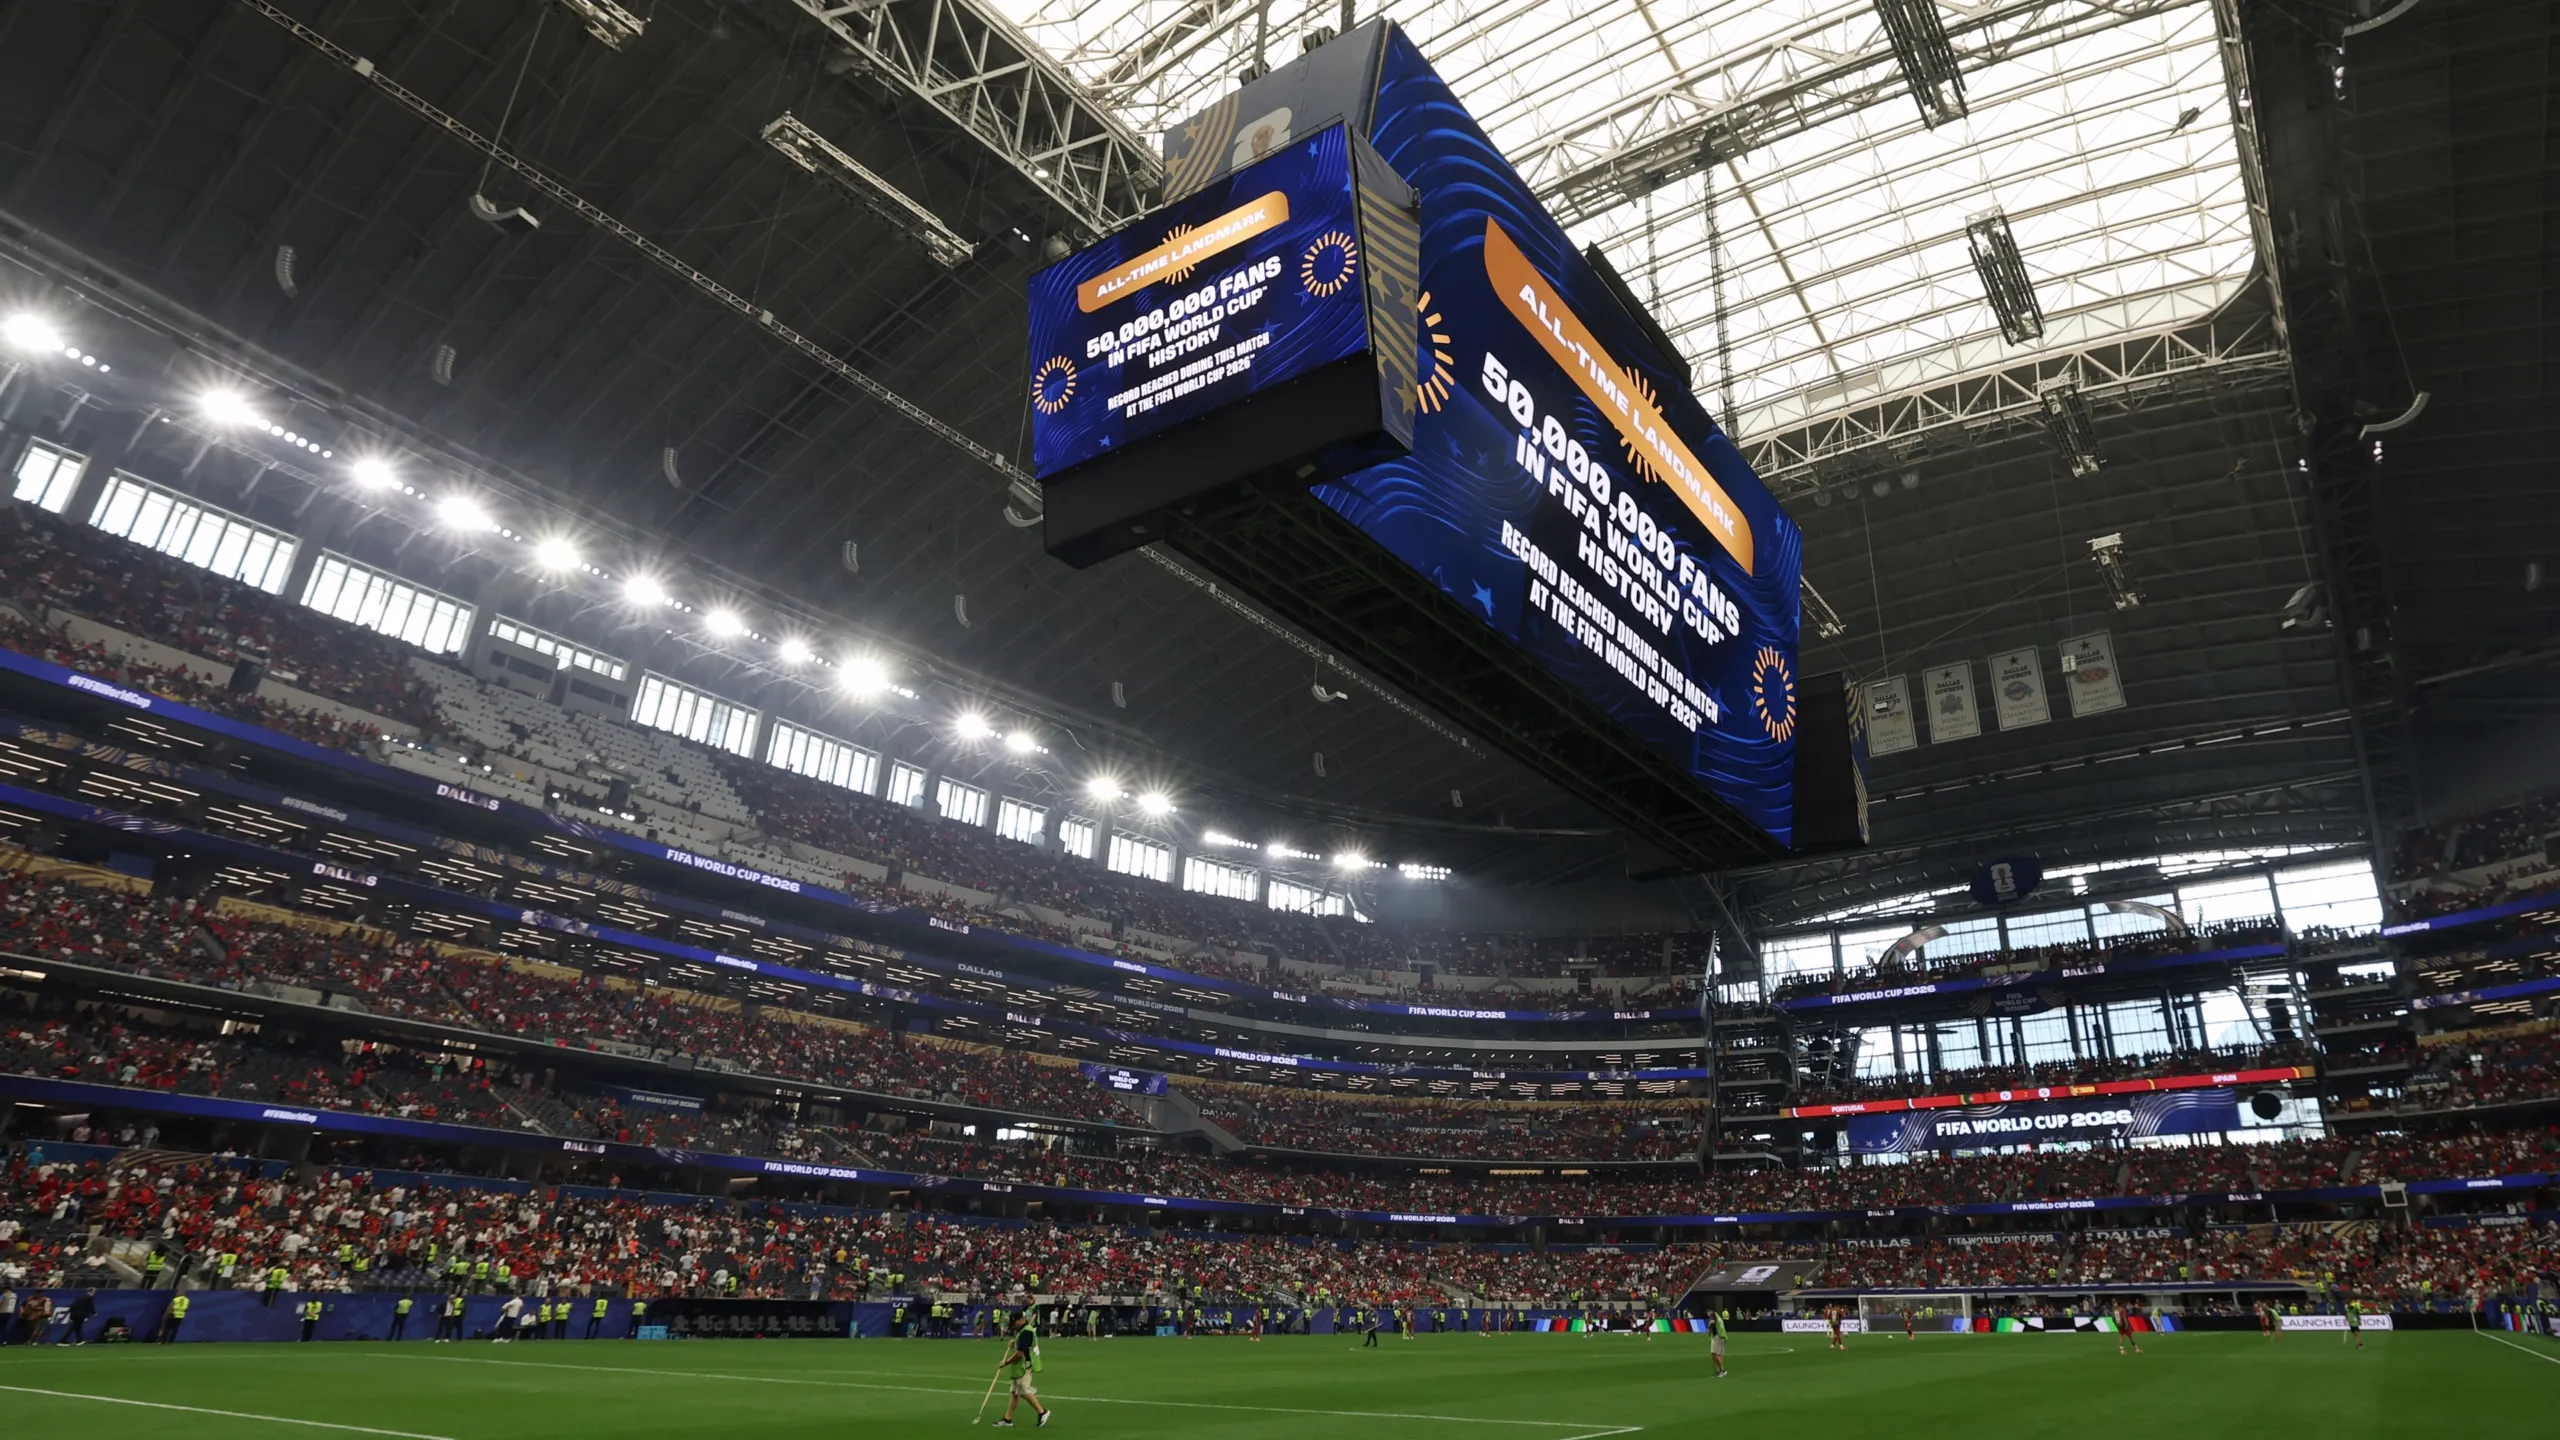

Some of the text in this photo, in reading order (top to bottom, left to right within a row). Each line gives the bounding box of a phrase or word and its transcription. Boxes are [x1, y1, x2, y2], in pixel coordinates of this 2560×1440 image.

[1096, 208, 1267, 298] ALL-TIME LANDMARK
[1086, 255, 1283, 359] 50,000,000 FANS
[1107, 348, 1126, 369] IN
[1126, 332, 1164, 361] FIFA
[1163, 304, 1225, 343] WORLD
[1147, 323, 1222, 370] HISTORY
[1107, 331, 1271, 411] RECORD REACHED DURING THIS MATCH
[1126, 403, 1138, 419] AT
[1137, 395, 1155, 414] THE
[1154, 387, 1175, 406] FIFA
[1173, 373, 1206, 399] WORLD
[1206, 366, 1226, 385] CUP
[1518, 283, 1735, 538] ALL-TIME LANDMARK
[1481, 351, 1741, 637] 50,000,000 FANS
[1516, 433, 1546, 485] IN
[1548, 466, 1602, 540] FIFA
[1606, 519, 1681, 612] WORLD
[1578, 530, 1674, 636] HISTORY
[1500, 519, 1719, 724] RECORD REACHED DURING THIS MATCH
[1529, 578, 1550, 612] AT
[1550, 593, 1577, 635] THE
[1576, 615, 1604, 659] FIFA
[1605, 638, 1648, 691] WORLD
[1647, 675, 1670, 709] CUP
[436, 784, 500, 811] DALLAS
[313, 862, 379, 888] DALLAS
[666, 848, 801, 893] FIFA WORLD CUP 2026
[929, 916, 970, 935] DALLAS
[957, 963, 1003, 979] DALLAS
[2061, 965, 2106, 978] DALLAS
[1272, 991, 1307, 1003] DALLAS
[1831, 984, 1937, 1004] FIFA WORLD CUP 2026
[1114, 995, 1185, 1015] FIFA WORLD CUP 2026
[1408, 1006, 1507, 1020] FIFA WORLD CUP 2026
[1006, 1012, 1041, 1026] DALLAS
[1613, 1010, 1651, 1020] DALLAS
[1214, 1047, 1298, 1067] FIFA WORLD CUP 2026
[1108, 1074, 1141, 1085] WORLD CUP
[1118, 1069, 1131, 1078] FIFA
[1472, 1070, 1507, 1080] DALLAS
[2212, 1073, 2238, 1083] SPAIN
[631, 1094, 646, 1102] FIFA
[645, 1096, 668, 1104] WORLD
[1831, 1103, 1866, 1113] PORTUGAL
[1936, 1109, 2134, 1136] FIFA WORLD CUP 2026
[562, 1140, 606, 1154] DALLAS
[764, 1161, 858, 1179] FIFA WORLD CUP 2026
[983, 1182, 1013, 1193] DALLAS
[2227, 1192, 2263, 1202] DALLAS
[1867, 1209, 1895, 1218] DALLAS
[2011, 1200, 2096, 1211] FIFA WORLD CUP 2026
[1389, 1214, 1403, 1222] FIFA
[1402, 1214, 1424, 1222] WORLD
[1424, 1215, 1436, 1223] CUP
[1558, 1217, 1584, 1225] DALLAS
[2096, 1229, 2173, 1241] DALLAS
[1786, 1321, 1825, 1330] LAUNCH
[2281, 1318, 2332, 1328] LAUNCH
